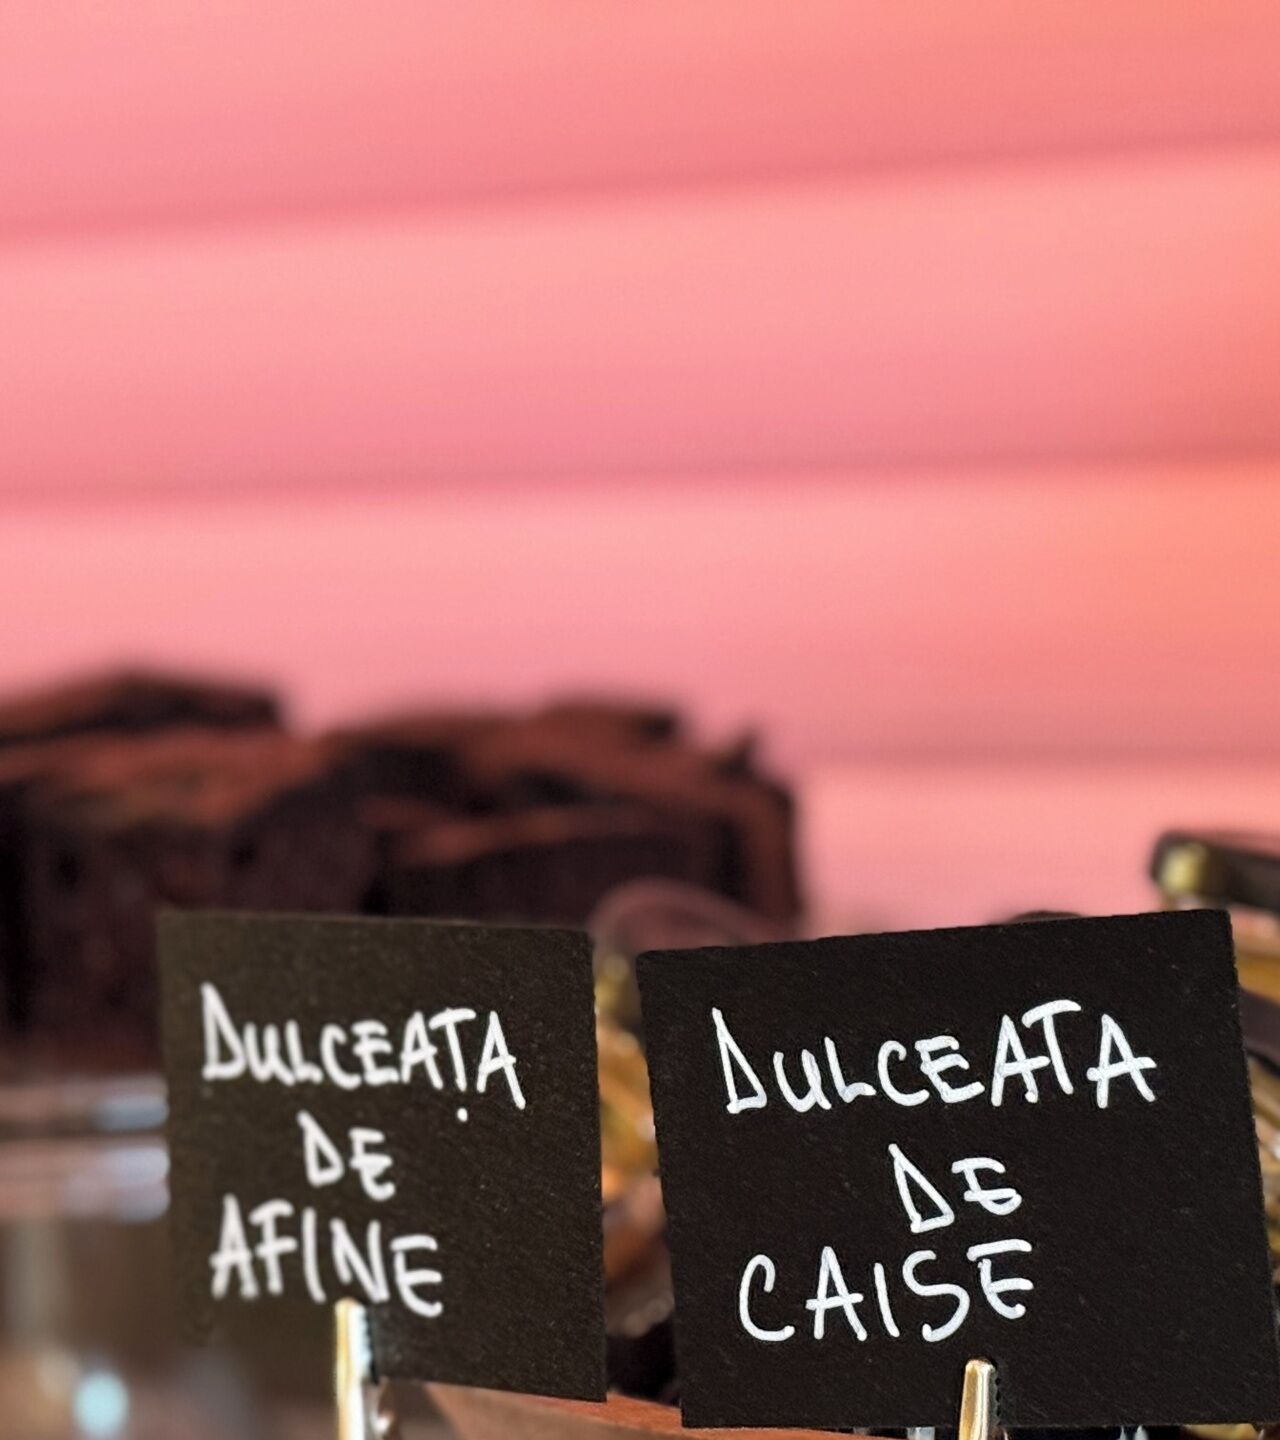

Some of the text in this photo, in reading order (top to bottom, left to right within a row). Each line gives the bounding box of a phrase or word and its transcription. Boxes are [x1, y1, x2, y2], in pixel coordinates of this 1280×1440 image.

[710, 998, 1158, 1116] DULCEATA
[296, 1110, 397, 1202] DE
[887, 1142, 1024, 1235] DE
[209, 1194, 444, 1319] AFINE
[738, 1237, 1035, 1344] CAISE
